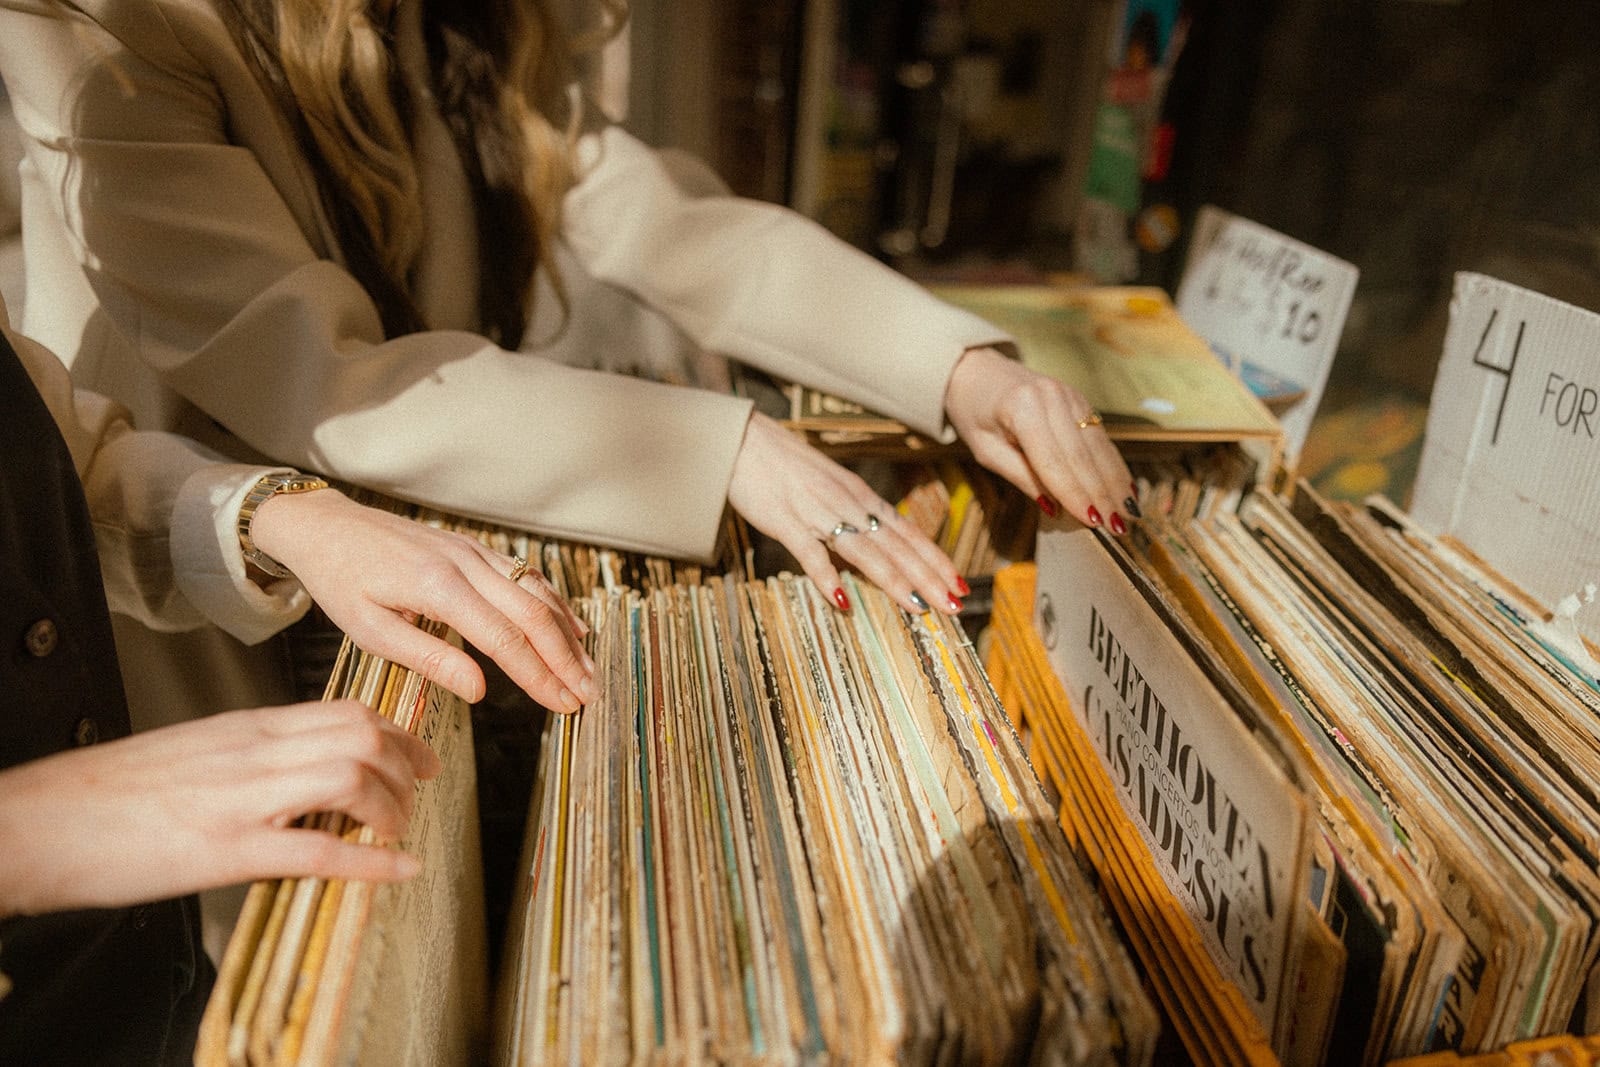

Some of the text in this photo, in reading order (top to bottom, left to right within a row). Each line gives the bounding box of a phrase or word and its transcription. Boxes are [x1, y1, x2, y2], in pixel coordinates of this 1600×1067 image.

[1473, 308, 1598, 446] 4 FOR
[1083, 685, 1270, 1004] CASADESUS
[1088, 604, 1284, 922] BEETHOVEN
[1115, 701, 1141, 750] PIANO
[1142, 743, 1199, 841] CONCERTOS
